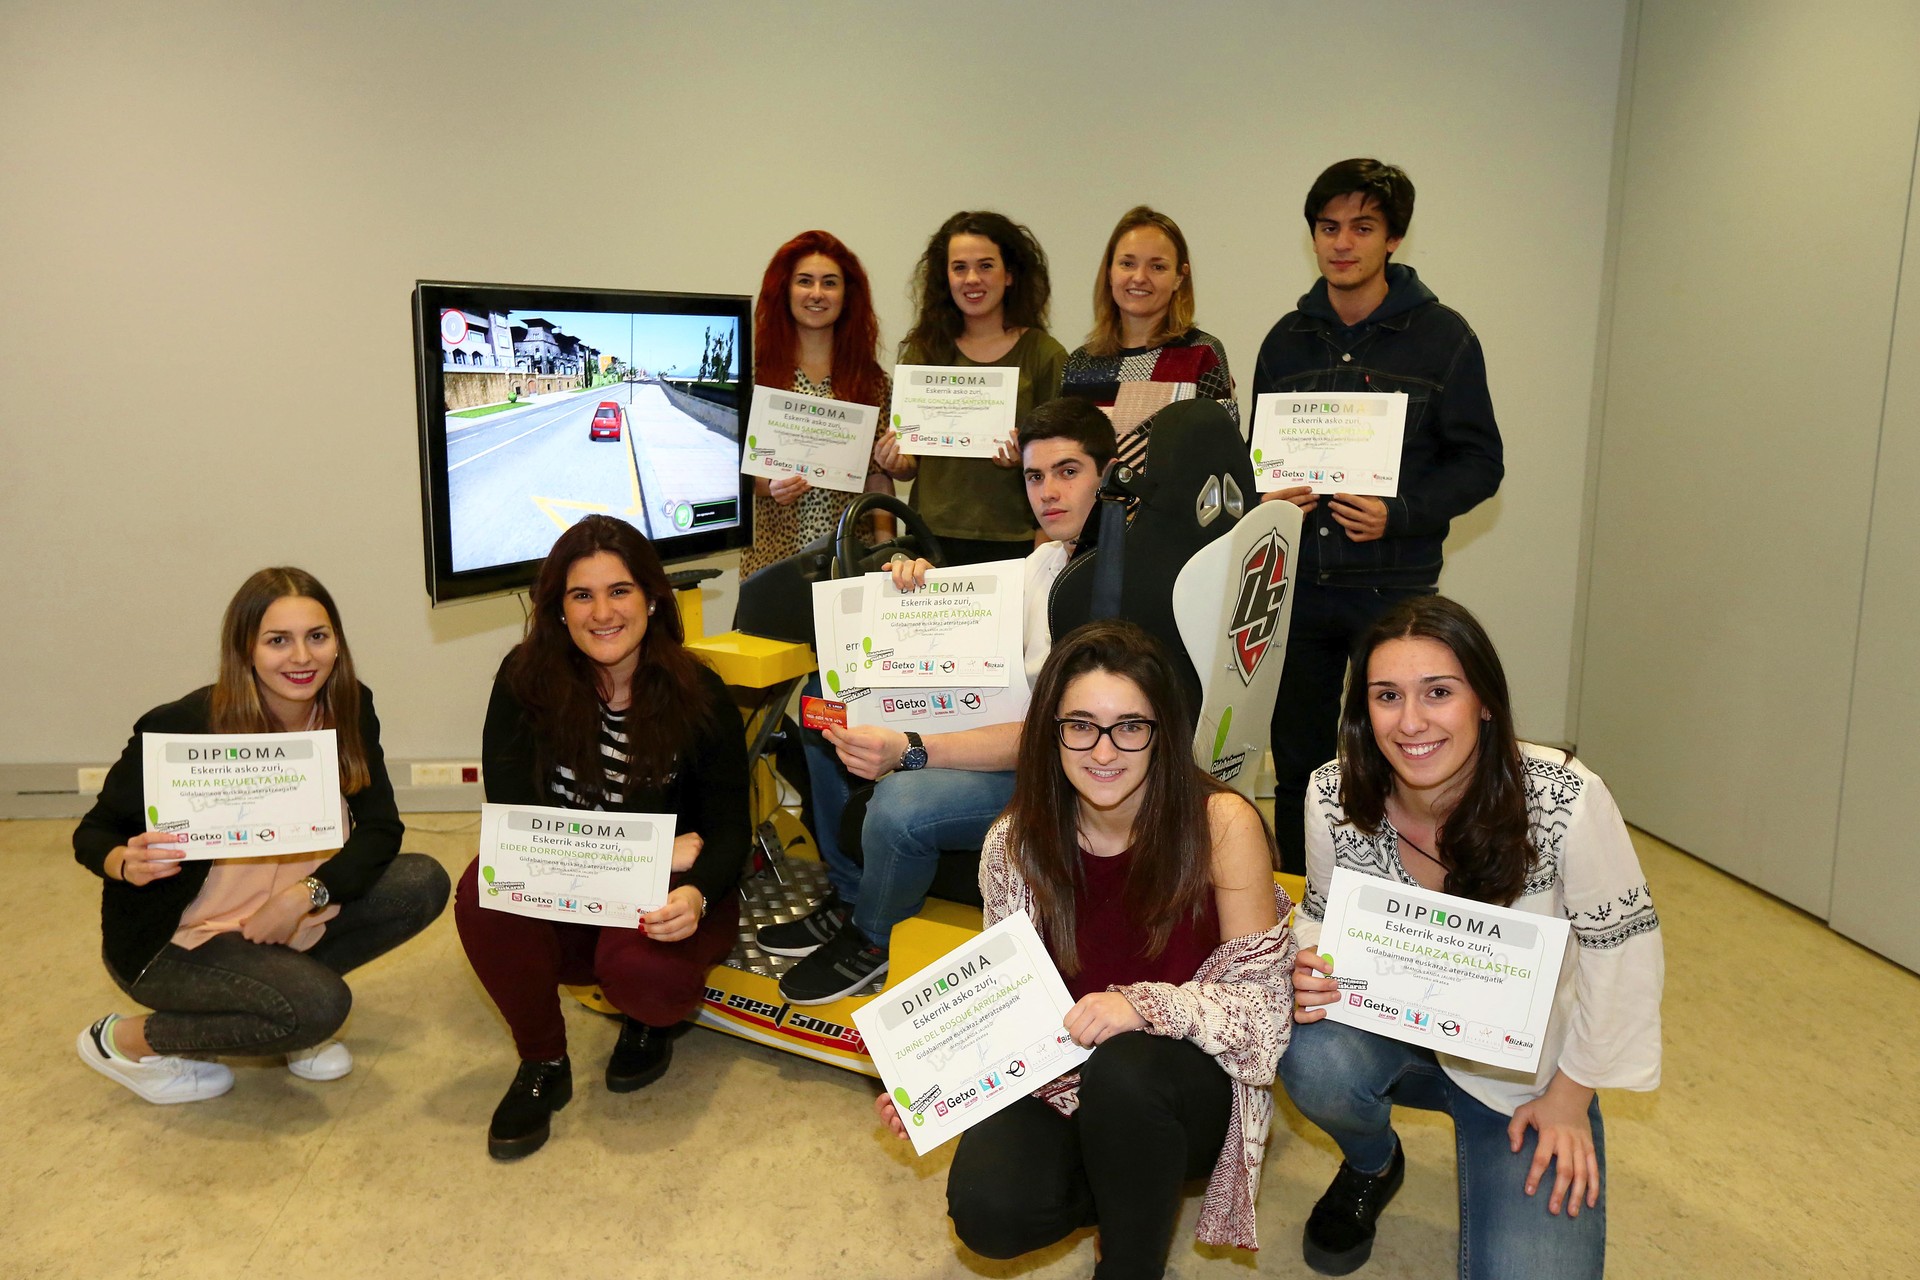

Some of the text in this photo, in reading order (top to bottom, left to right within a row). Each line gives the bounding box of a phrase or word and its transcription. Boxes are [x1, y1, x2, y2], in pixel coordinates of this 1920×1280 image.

[926, 376, 985, 385] DIPLOMA
[785, 401, 845, 419] DIPLOMA
[1293, 404, 1366, 413] DIPLOMA
[768, 420, 800, 431] MAIALEN
[784, 414, 842, 430] Eskerrik asko zuri,
[773, 460, 792, 468] Getxo
[901, 597, 971, 607] Eskerrik asko zuri,
[881, 610, 992, 620] JON BASARRATE ATXURRA
[846, 642, 860, 651] err
[845, 663, 857, 672] JO
[892, 662, 915, 670] Getxo
[896, 699, 926, 710] Getxo
[189, 747, 286, 760] DIPLOMA
[191, 766, 231, 774] Eskerrik
[262, 765, 284, 773] zuri,
[172, 779, 210, 787] MARTA
[214, 777, 271, 786] REVUELTA
[532, 818, 625, 837] DIPLOMA
[190, 832, 222, 841] Getxo
[532, 835, 621, 852] Eskerrik asko zuri,
[501, 843, 653, 863] EIDER DORRONSORO ARANBURU
[524, 895, 553, 904] Getxo
[1386, 898, 1502, 938] DIPLOMA
[1385, 920, 1494, 956] Eskerrik asko zuri,
[1348, 927, 1530, 979] GARAZI LEJARZA GALLASTEGI
[1366, 946, 1504, 984] Gidabaimena euskaraz ateratzeagatik
[902, 954, 991, 1015] DIPLOMA
[913, 975, 998, 1029] Eskerrik asko zuri,
[1363, 998, 1399, 1015] Getxo
[727, 994, 791, 1028] seat
[895, 973, 1034, 1060] ZURIÑE DEL BOSQUE ARRIZABALAGA
[916, 995, 1021, 1060] Gidabaimena euskaraz ateratzeagatik
[1509, 1038, 1533, 1048] Bizkaia
[947, 1088, 976, 1108] Getxo
